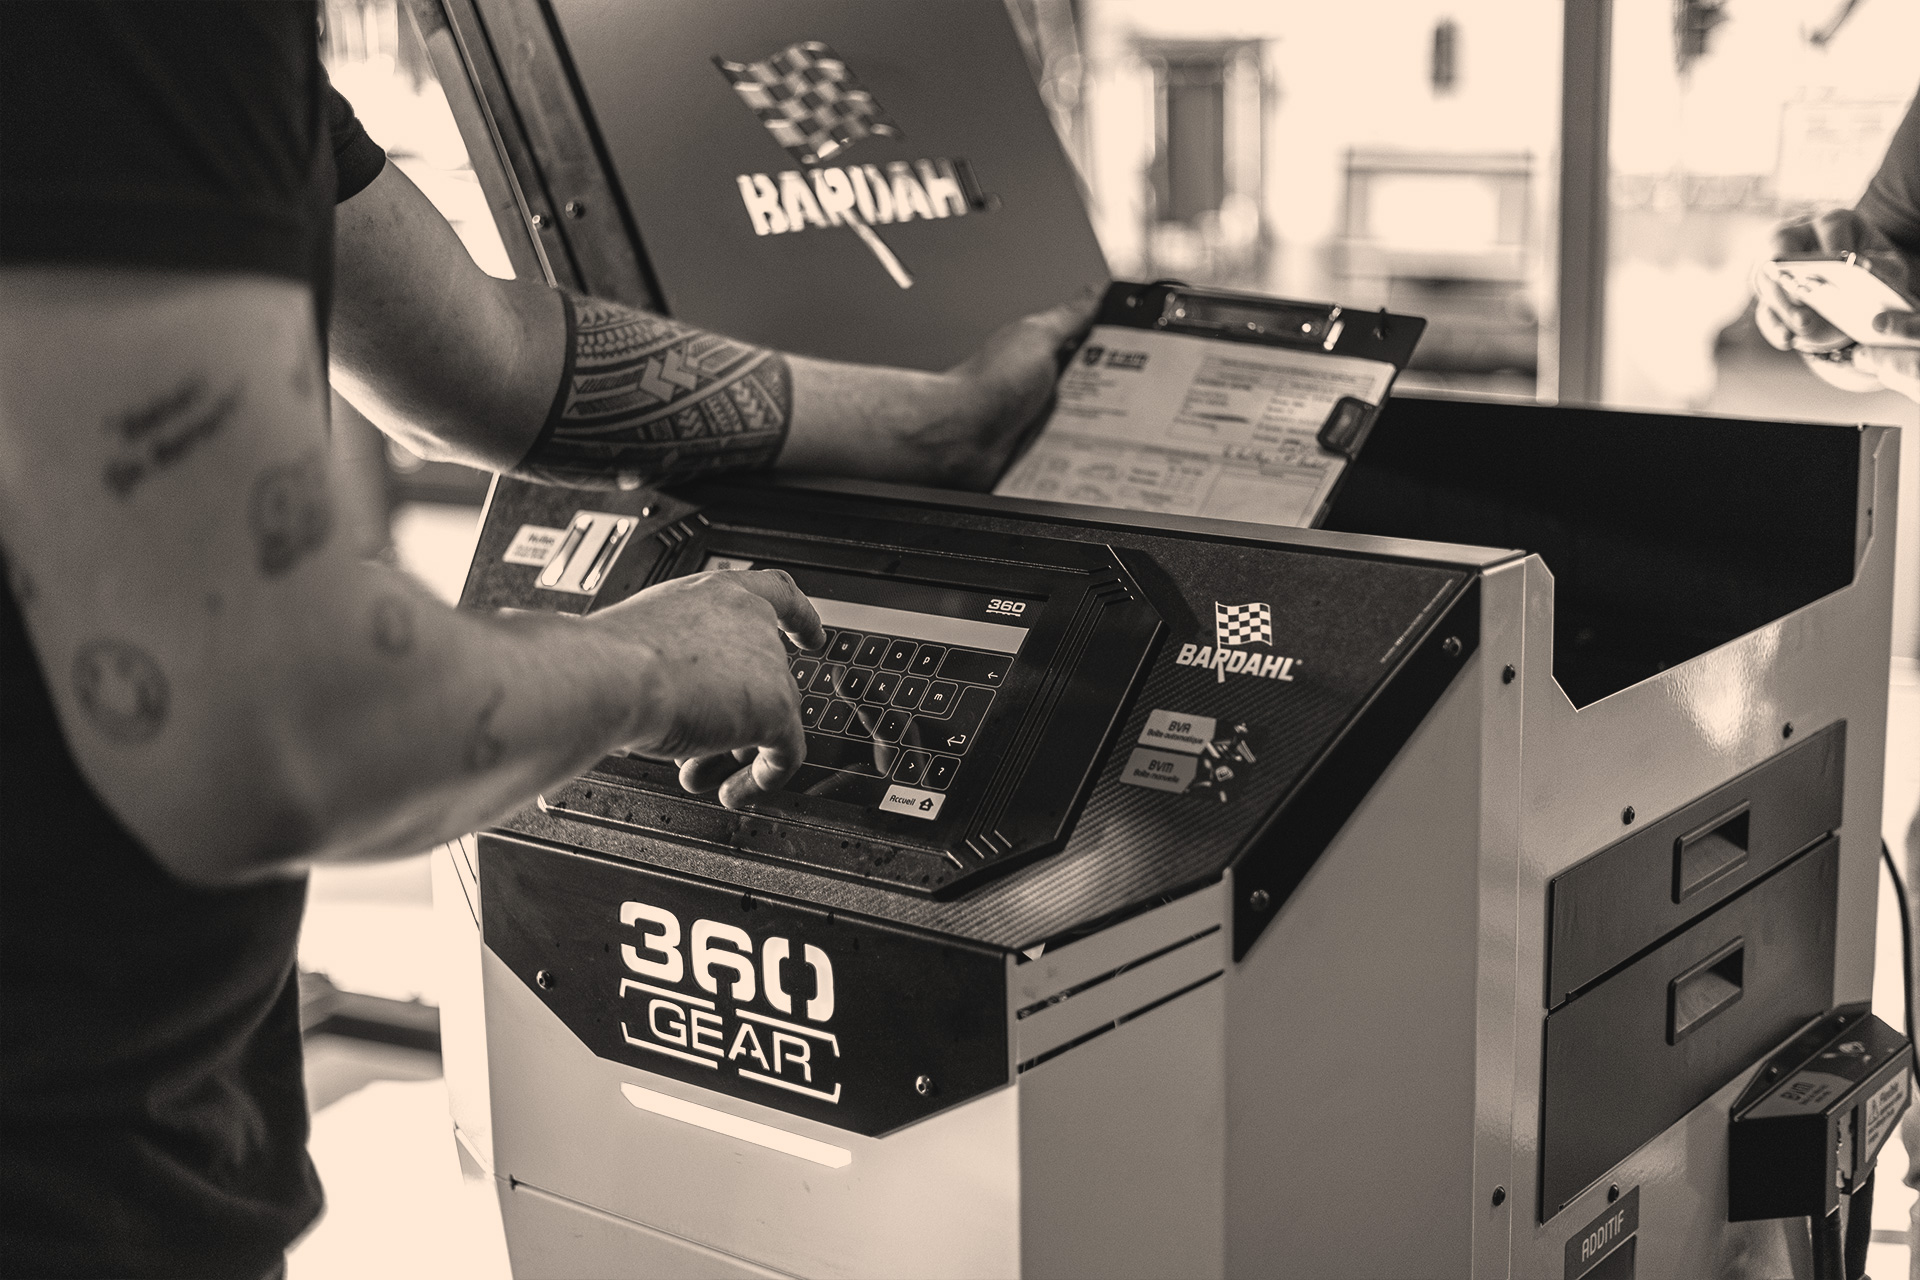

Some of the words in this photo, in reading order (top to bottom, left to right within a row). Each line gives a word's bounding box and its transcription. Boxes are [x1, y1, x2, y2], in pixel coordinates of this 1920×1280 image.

[987, 598, 1026, 613] 360
[922, 656, 931, 665] p
[1175, 643, 1294, 682] BARDAHL
[796, 670, 805, 679] g
[824, 674, 831, 682] h
[878, 682, 886, 691] k
[806, 707, 814, 715] n
[889, 794, 916, 806] Accueil
[619, 900, 835, 1023] 360
[649, 998, 812, 1083] GEAR
[1581, 1209, 1624, 1263] ADDITIF
